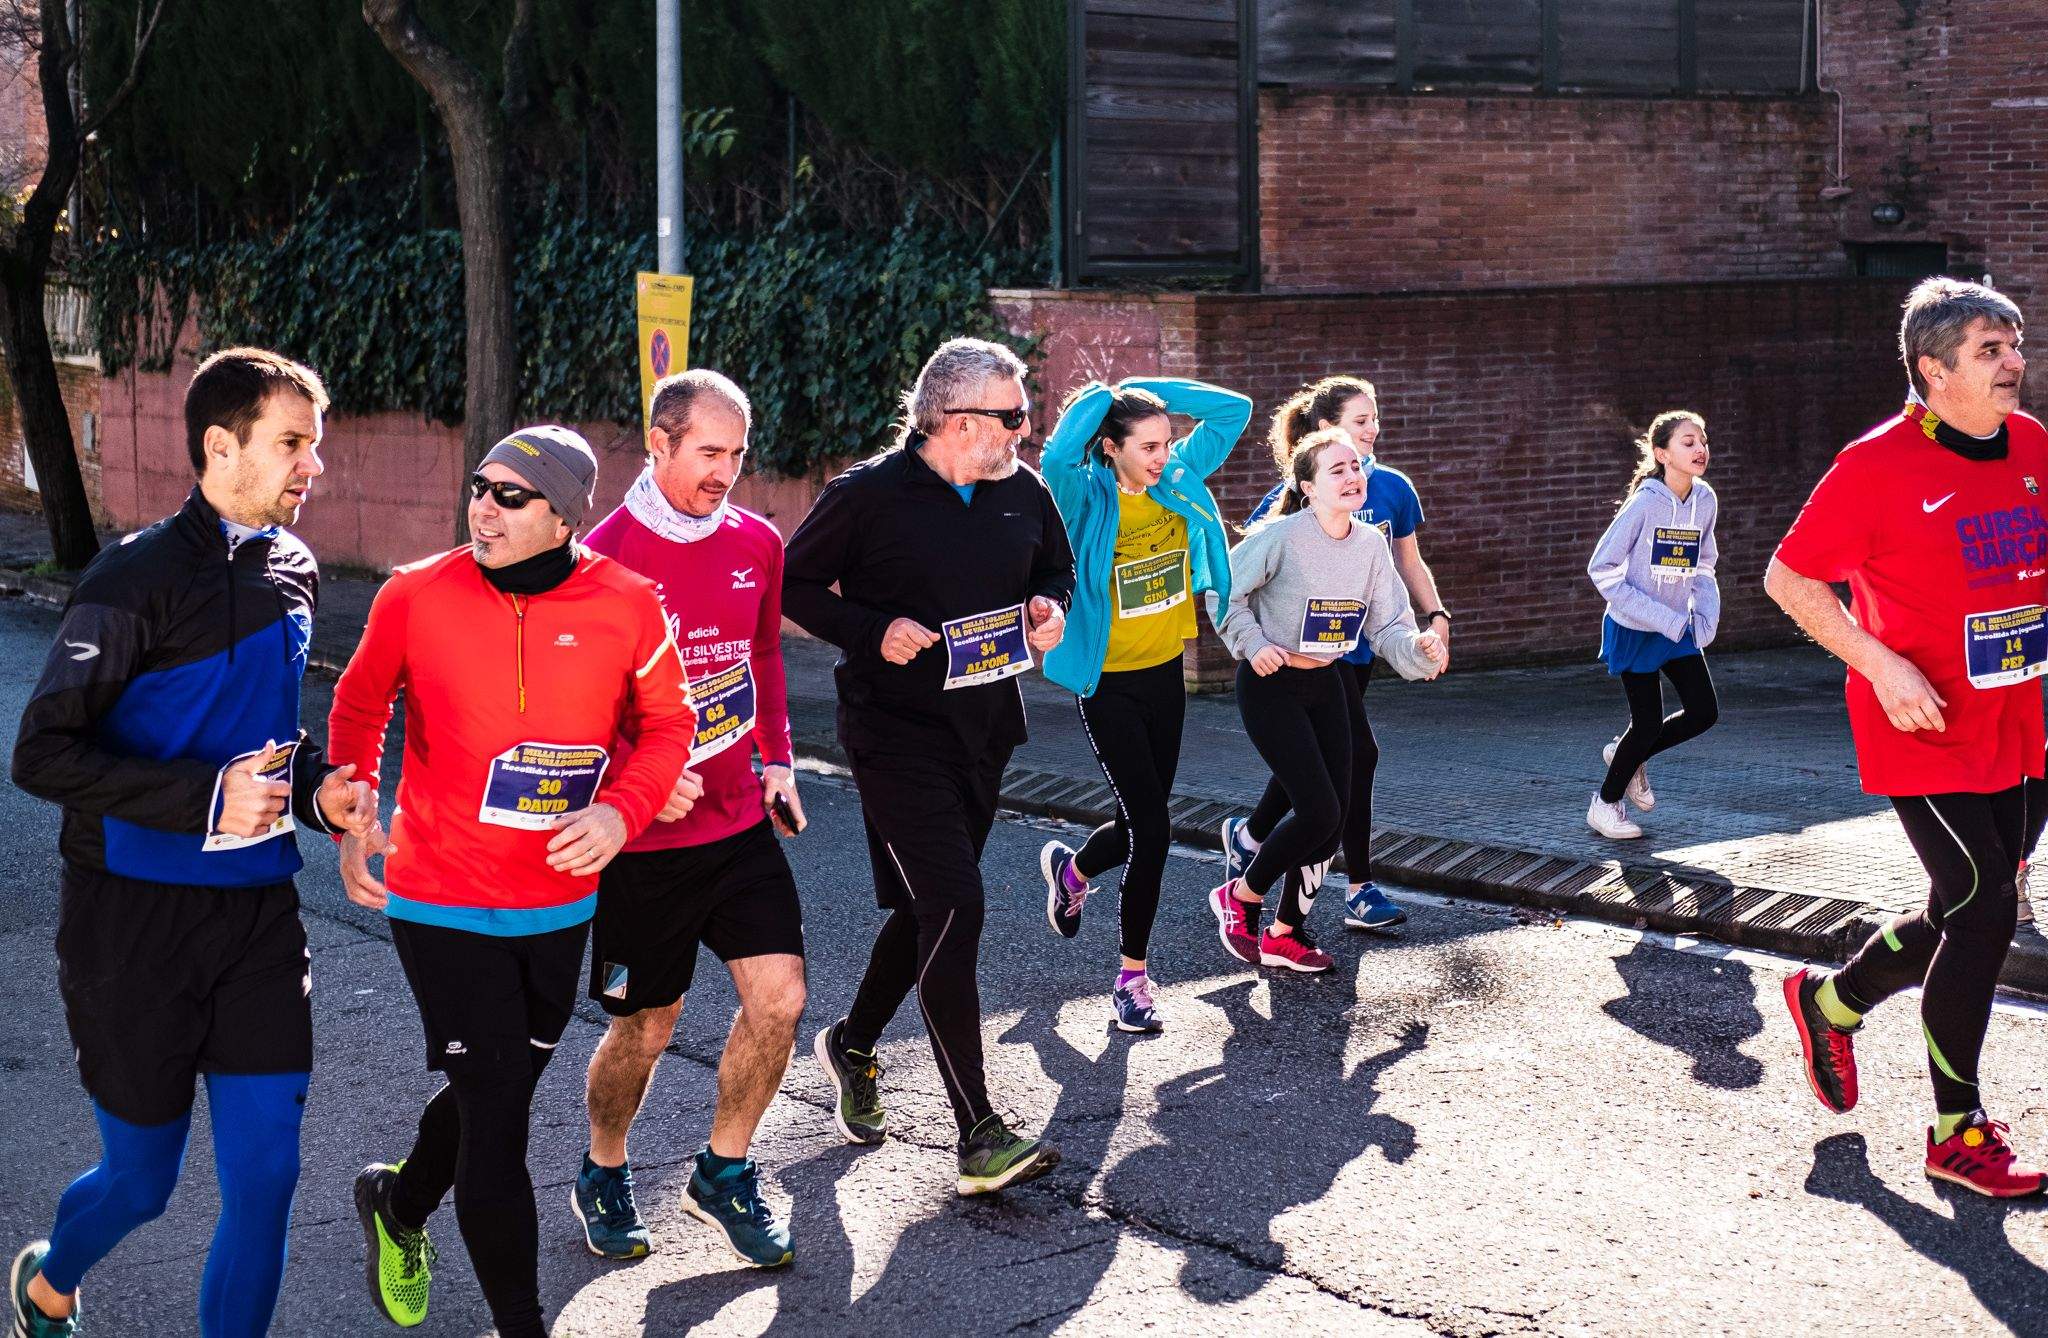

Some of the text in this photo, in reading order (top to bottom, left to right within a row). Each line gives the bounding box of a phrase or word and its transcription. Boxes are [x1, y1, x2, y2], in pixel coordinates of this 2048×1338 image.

[1956, 506, 2048, 544] CURSA
[1962, 533, 2048, 570] BARÇA
[1145, 576, 1165, 592] 150
[1143, 588, 1169, 604] GINA
[962, 619, 985, 630] MILLA
[963, 617, 1016, 636] DE VALLDOREIX
[1329, 619, 1342, 630] 32
[1971, 618, 1987, 632] 4A
[1989, 614, 2012, 624] MILLA
[1989, 614, 2041, 631] DE VALLDOREIX
[688, 626, 720, 640] edició
[949, 626, 961, 639] 4A
[953, 625, 1019, 648] Recollida de joguines
[1974, 632, 2010, 641] Recollida
[2019, 623, 2045, 634] joguines
[694, 639, 751, 657] SILVESTRE
[980, 640, 997, 657] 34
[2005, 637, 2023, 654] 14
[715, 653, 732, 663] Sant
[965, 652, 1010, 674] ALFONS
[2001, 655, 2026, 670] PEP
[719, 682, 749, 701] joguines
[705, 703, 726, 722] 62
[697, 715, 740, 745] ROGER
[522, 756, 537, 764] DE
[538, 758, 594, 767] VALLDOREIX
[524, 748, 603, 760] MILLA SOLIDÀRIA
[501, 762, 548, 776] Recollida
[561, 768, 595, 778] joguines
[537, 779, 562, 795] 30
[516, 796, 569, 813] DAVID
